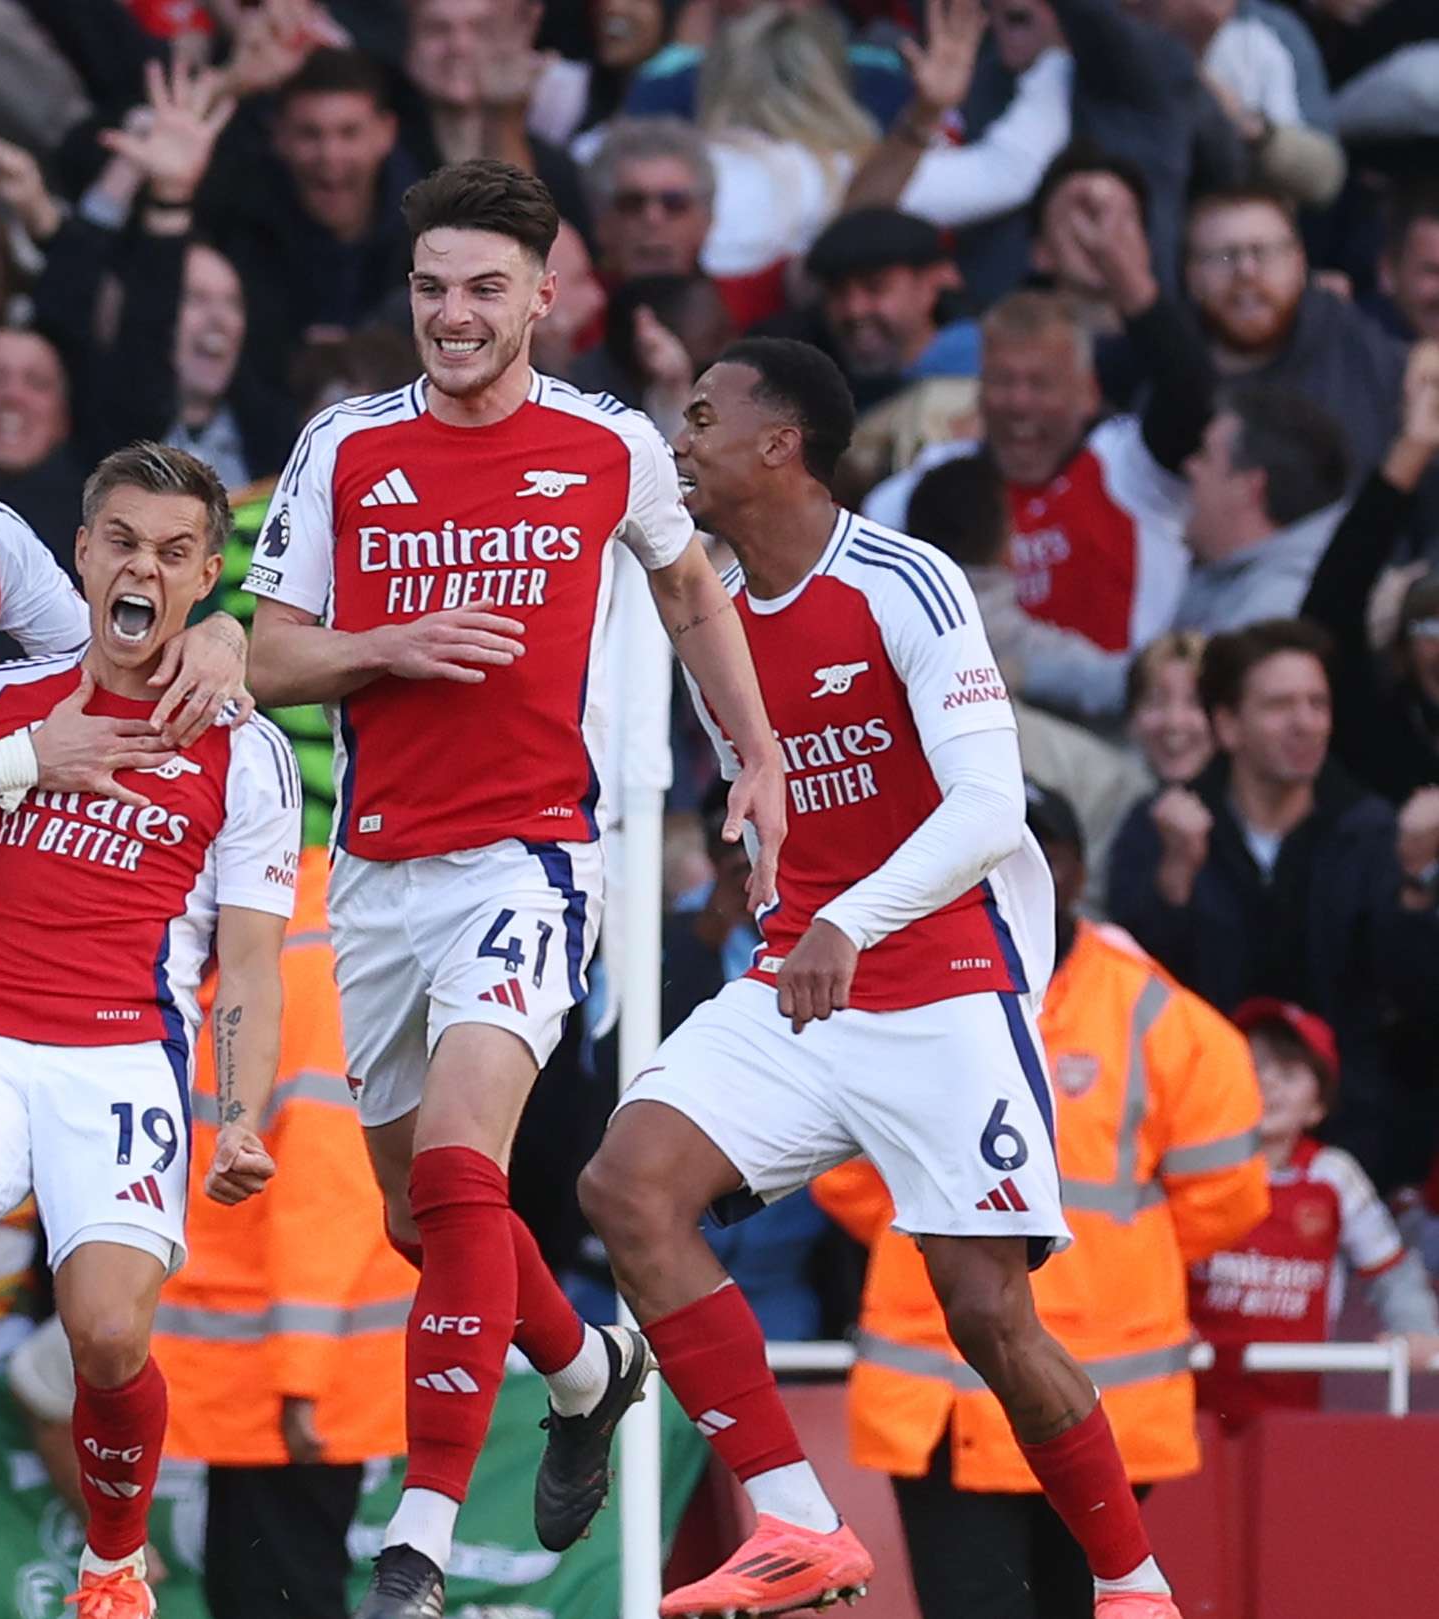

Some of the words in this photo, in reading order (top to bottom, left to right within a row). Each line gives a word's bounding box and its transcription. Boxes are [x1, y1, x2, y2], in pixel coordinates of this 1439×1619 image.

[358, 519, 581, 573] Emirates
[387, 575, 435, 614] FLY
[442, 568, 547, 610] BETTER
[943, 686, 1007, 710] RWAND
[955, 667, 997, 686] VISIT
[789, 762, 879, 814] BETTER
[37, 817, 144, 871] BETTER
[478, 908, 553, 990] 41
[111, 1102, 178, 1173] 19
[980, 1098, 1028, 1171] 6
[421, 1313, 481, 1336] AFC
[83, 1437, 143, 1464] AFC
